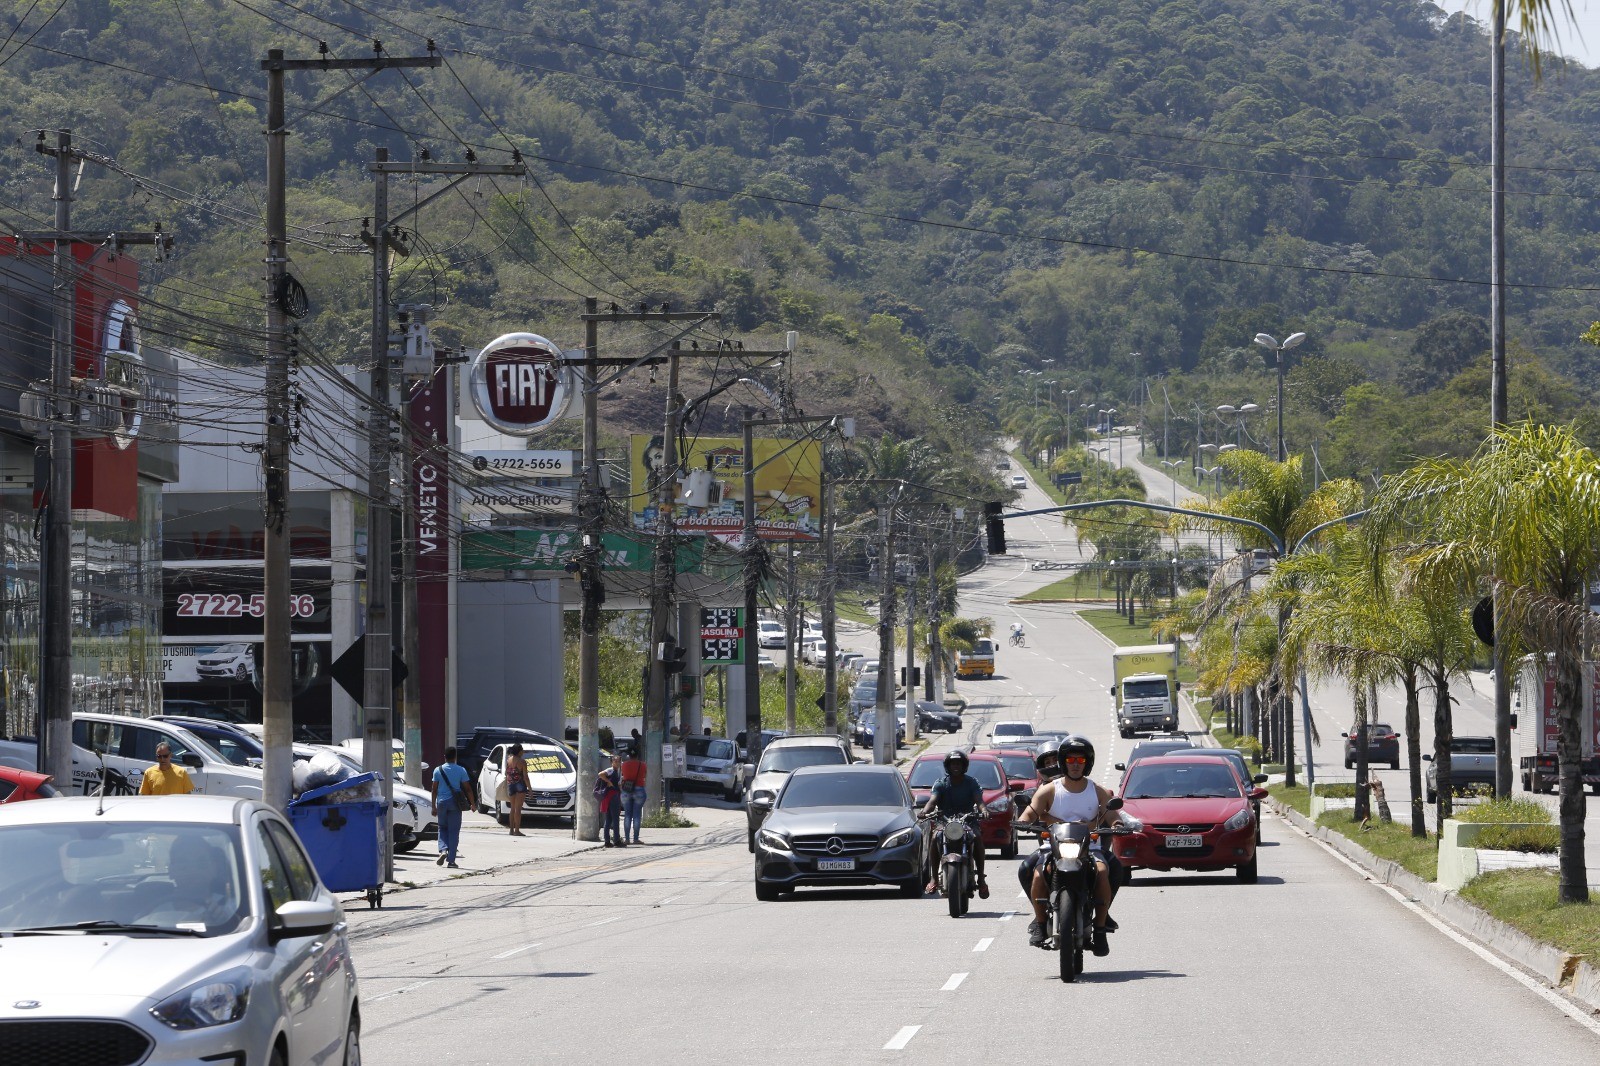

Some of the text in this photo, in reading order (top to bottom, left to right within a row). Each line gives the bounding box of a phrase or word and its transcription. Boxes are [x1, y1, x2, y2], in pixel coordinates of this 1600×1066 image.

[495, 363, 557, 407] FIAT
[493, 457, 562, 470] 2722-5656
[472, 494, 562, 506] AUTOCENTRO
[419, 464, 438, 555] VENETO
[689, 516, 709, 526] boa
[711, 517, 740, 527] assim
[754, 519, 771, 528] em
[772, 520, 799, 530] casa!
[170, 647, 196, 657] USADO!
[72, 770, 97, 779] ISSAN
[1167, 838, 1202, 847] KZF-7923
